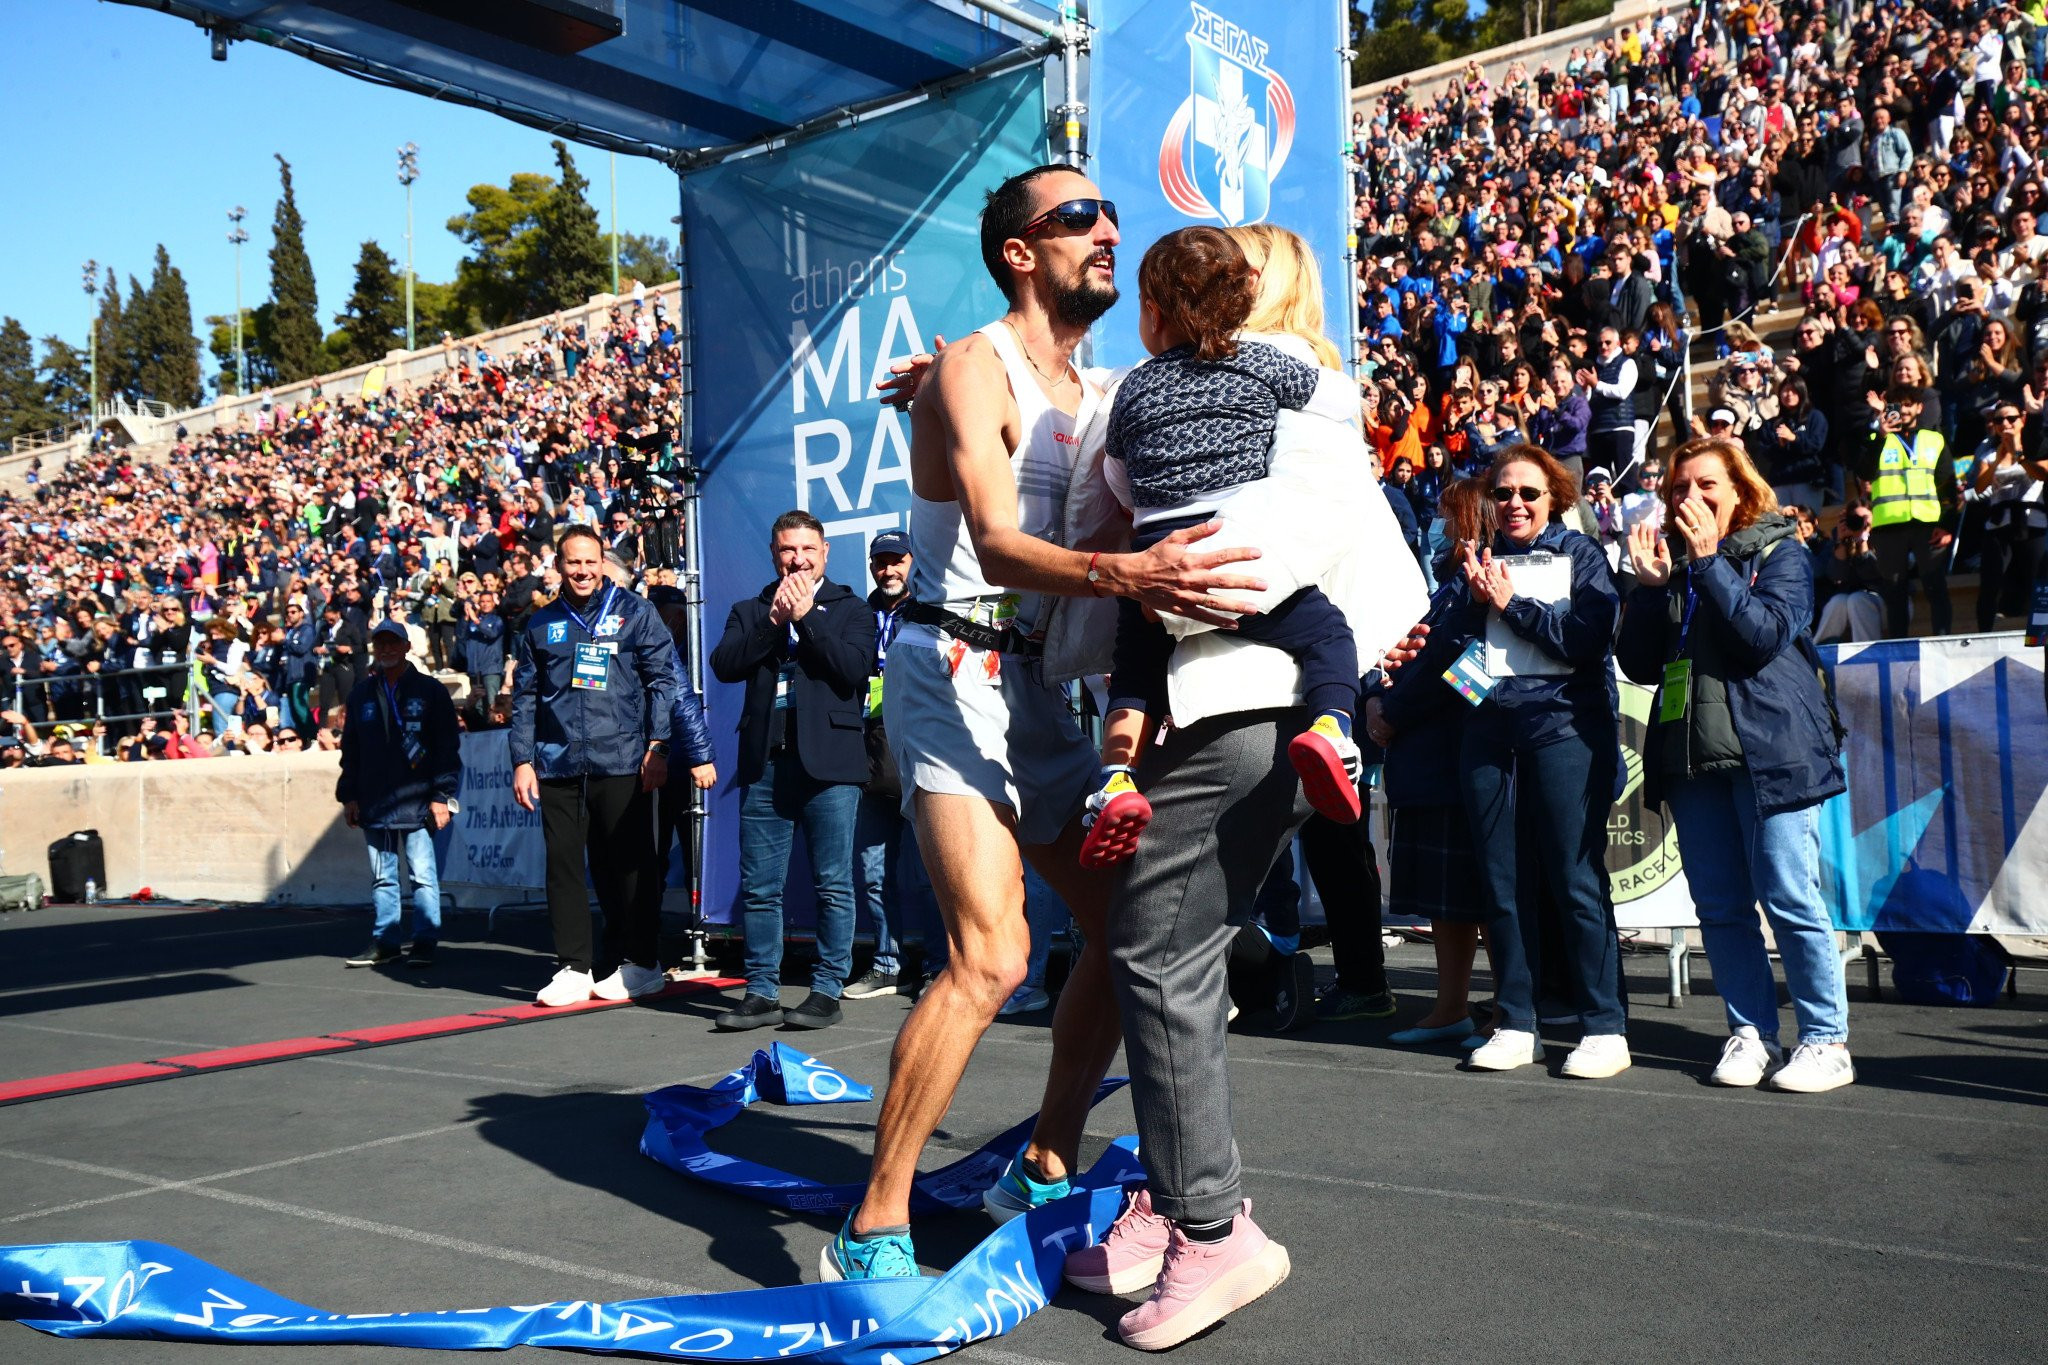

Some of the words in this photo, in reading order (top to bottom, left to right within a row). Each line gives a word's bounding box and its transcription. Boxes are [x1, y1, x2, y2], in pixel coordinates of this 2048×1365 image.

[790, 249, 907, 314] athens
[792, 295, 926, 414] MA
[793, 406, 913, 515] RA
[1619, 863, 1666, 891] RACE
